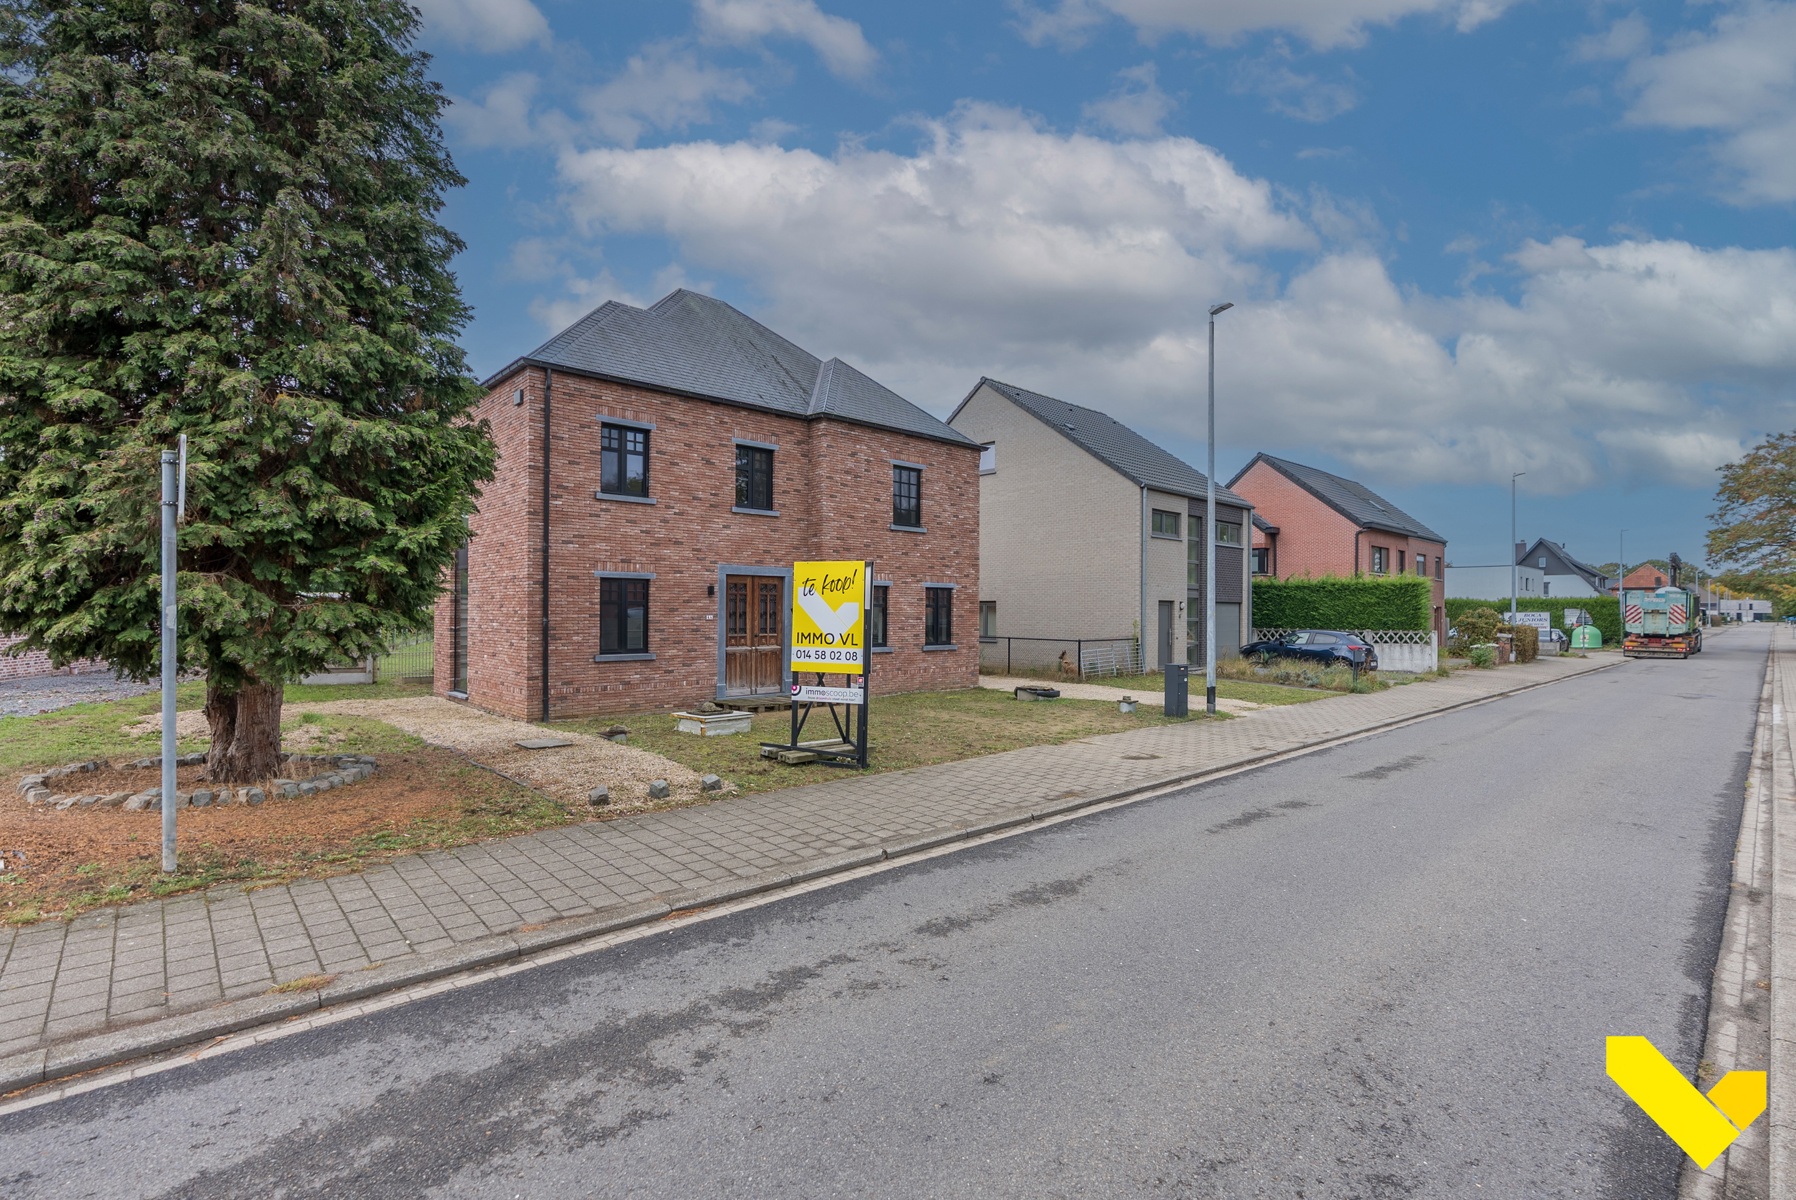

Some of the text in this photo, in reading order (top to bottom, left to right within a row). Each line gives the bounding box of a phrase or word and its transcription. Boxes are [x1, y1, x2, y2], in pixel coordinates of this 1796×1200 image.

[802, 568, 858, 597] te koop!
[796, 632, 859, 646] IMMO VL
[795, 649, 858, 661] 014 58 02 08
[805, 687, 859, 698] immoscoop.be
